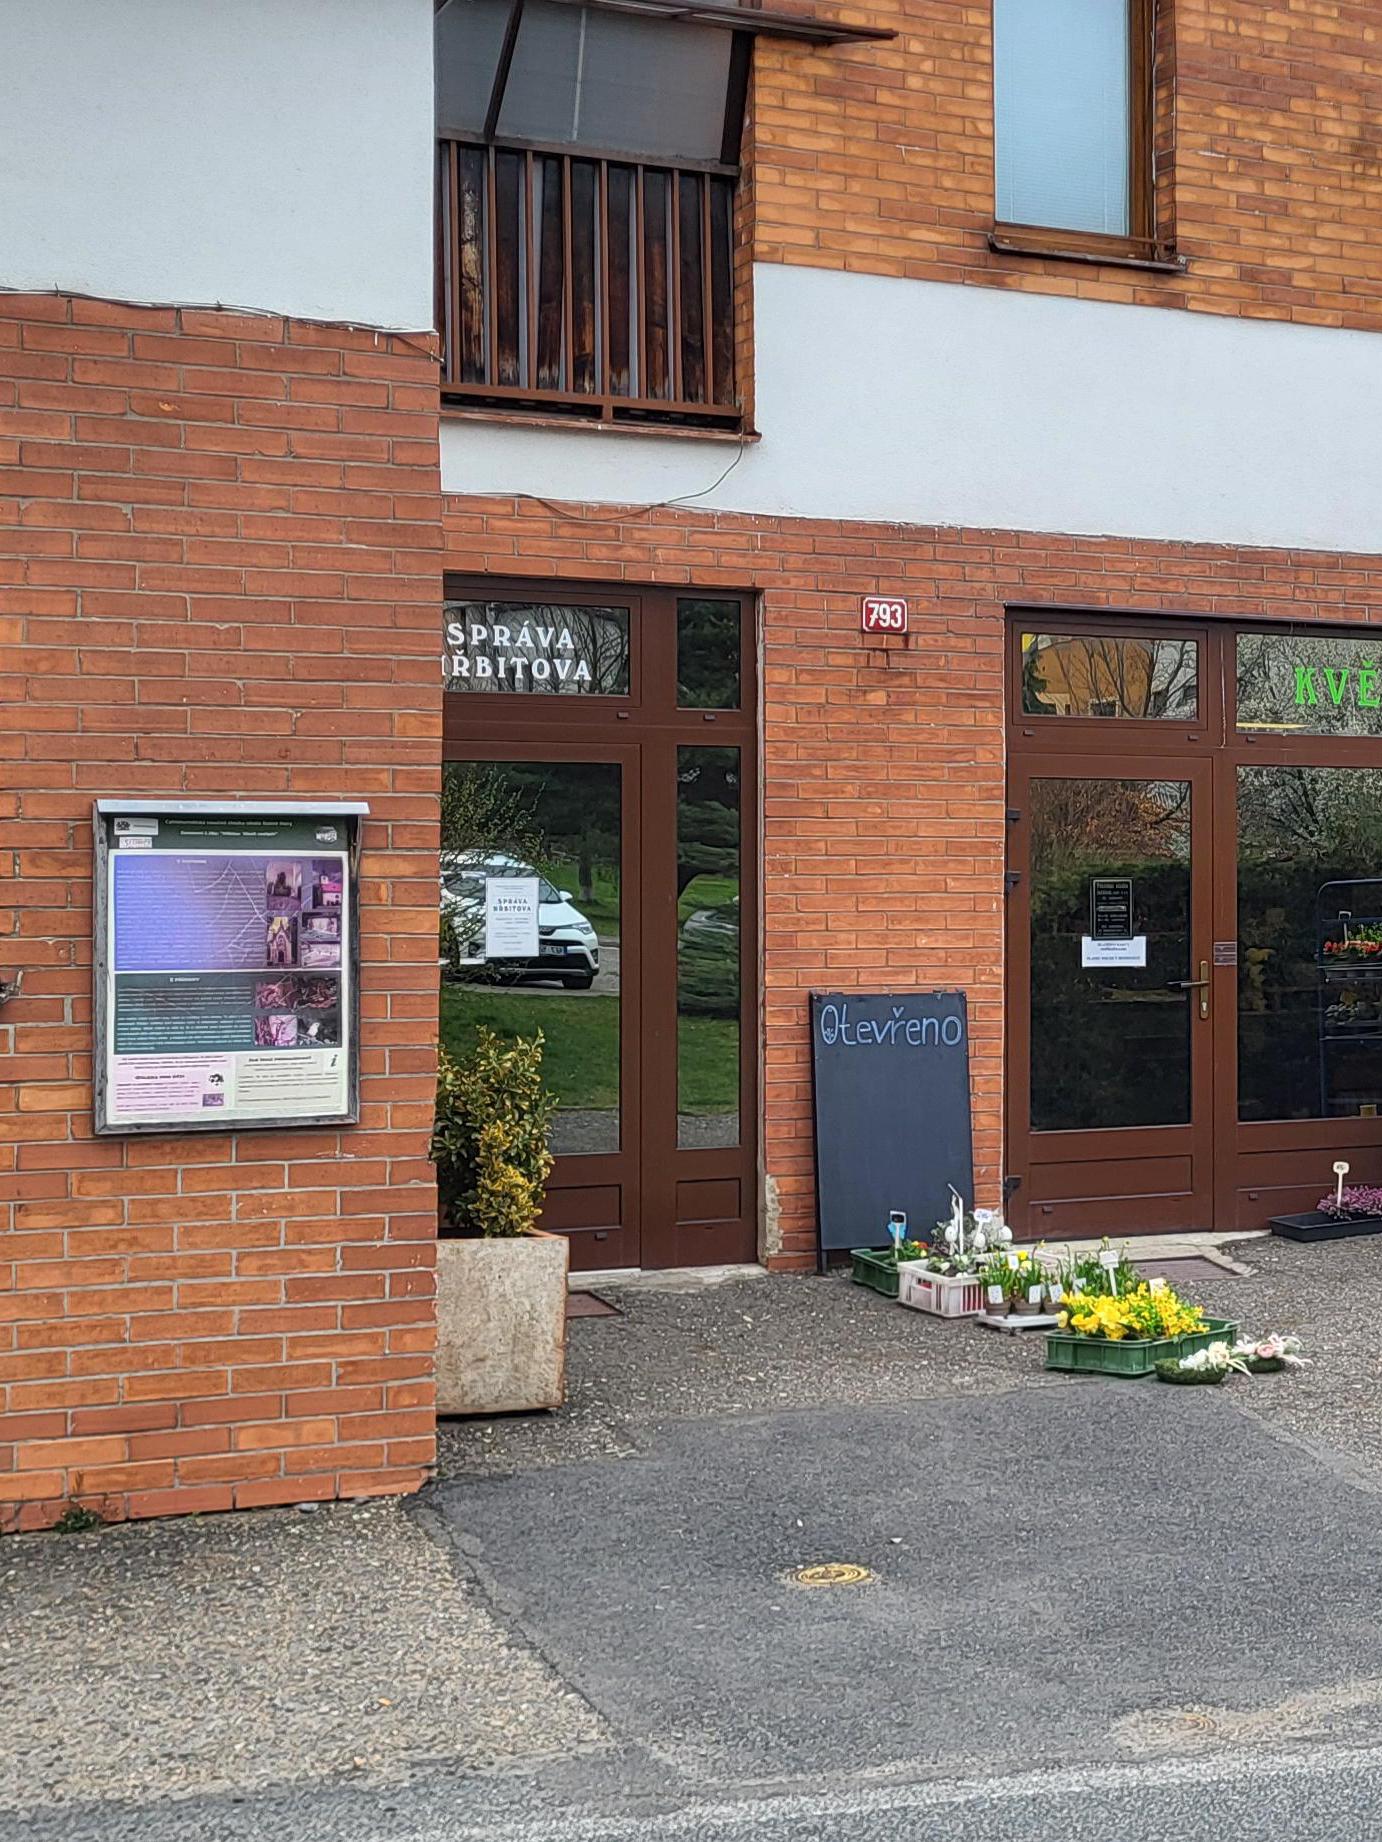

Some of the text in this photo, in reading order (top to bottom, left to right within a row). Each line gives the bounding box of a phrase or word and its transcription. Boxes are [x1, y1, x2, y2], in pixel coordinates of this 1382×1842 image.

[867, 603, 902, 628] 793
[446, 620, 575, 649] SPRÁVA
[820, 1003, 962, 1046] Otevřeno
